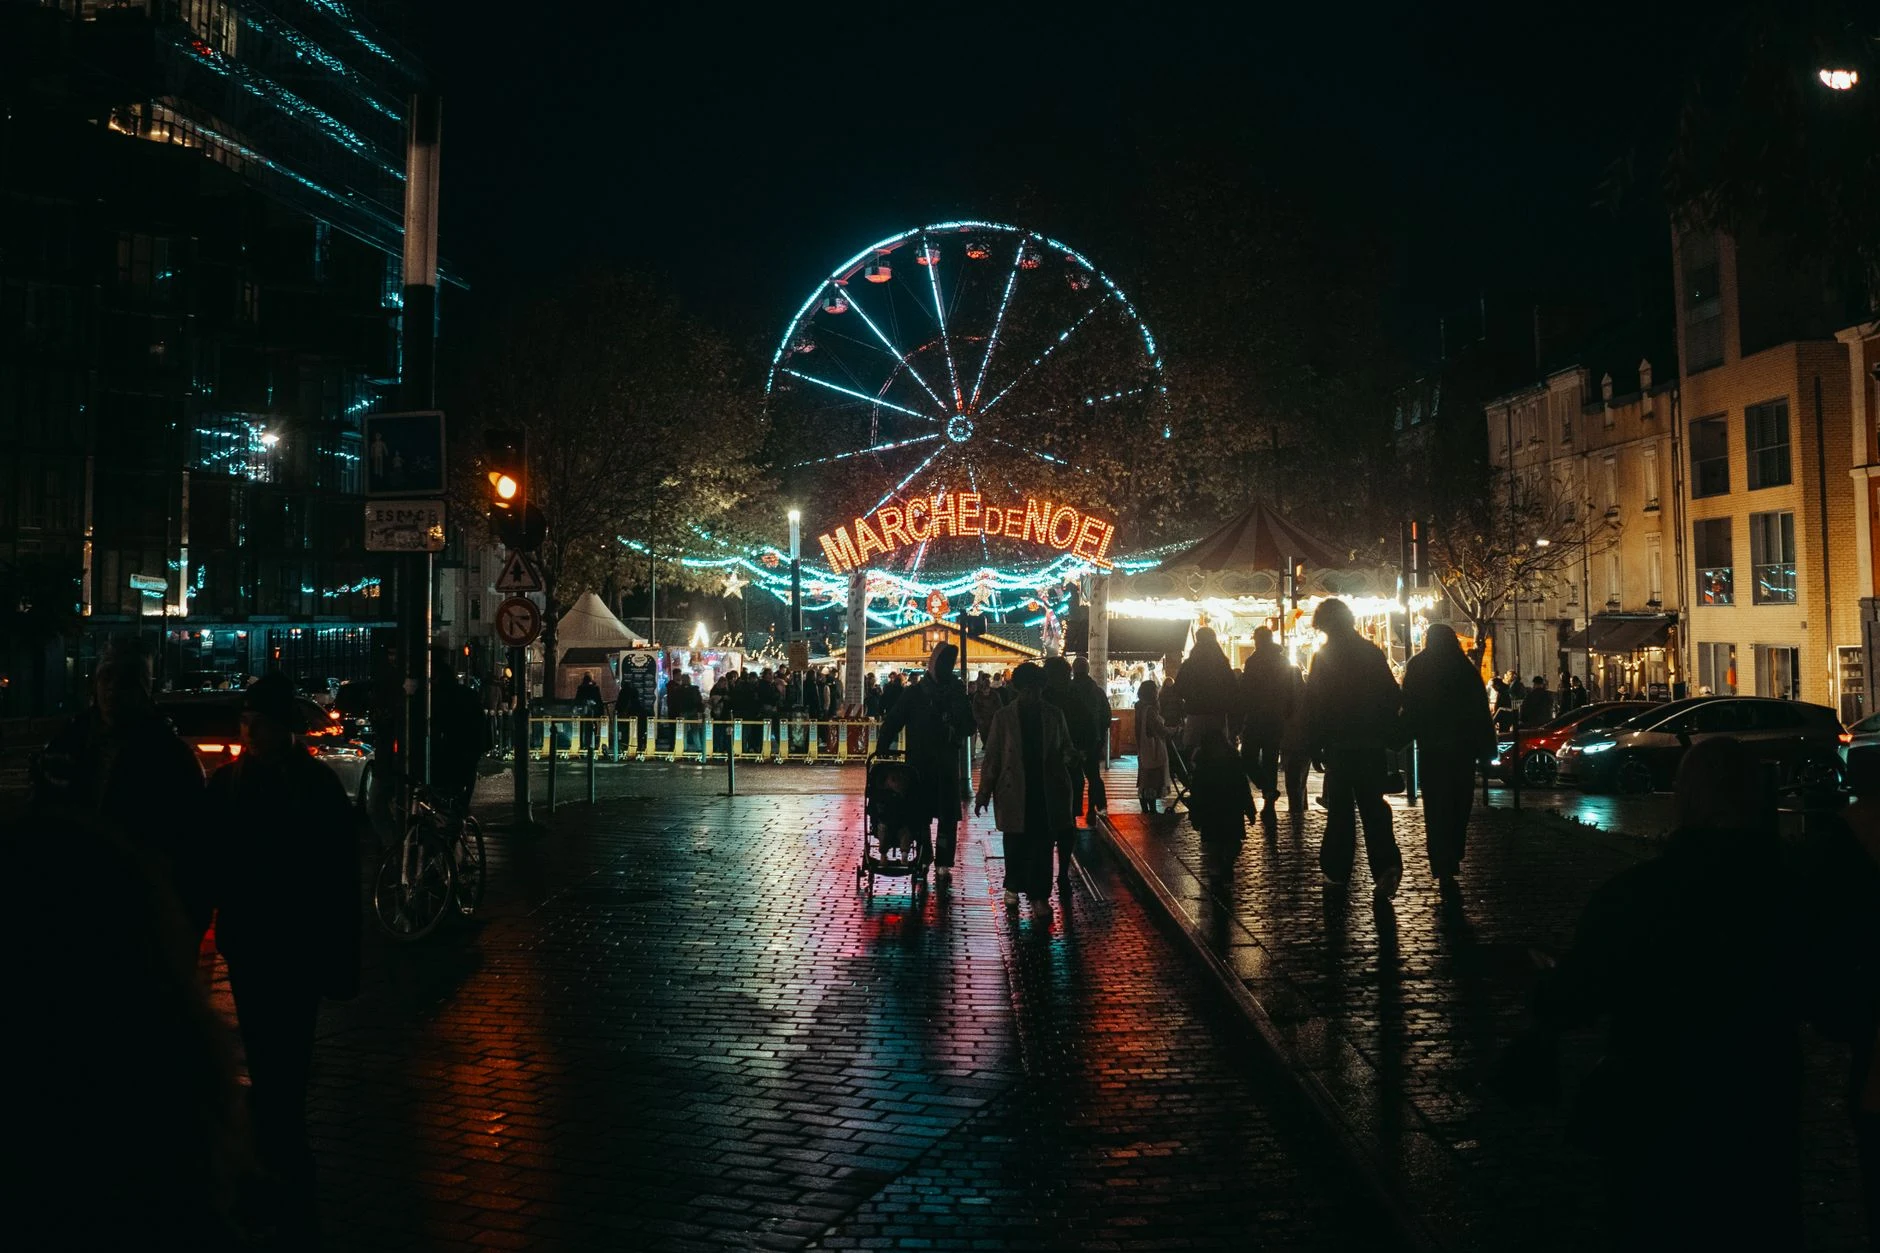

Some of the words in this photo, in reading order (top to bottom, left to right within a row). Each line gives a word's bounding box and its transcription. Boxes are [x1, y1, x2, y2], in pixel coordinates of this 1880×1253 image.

[818, 492, 981, 574] MARCHE
[985, 507, 1024, 538] DE
[1022, 498, 1115, 571] NOEL
